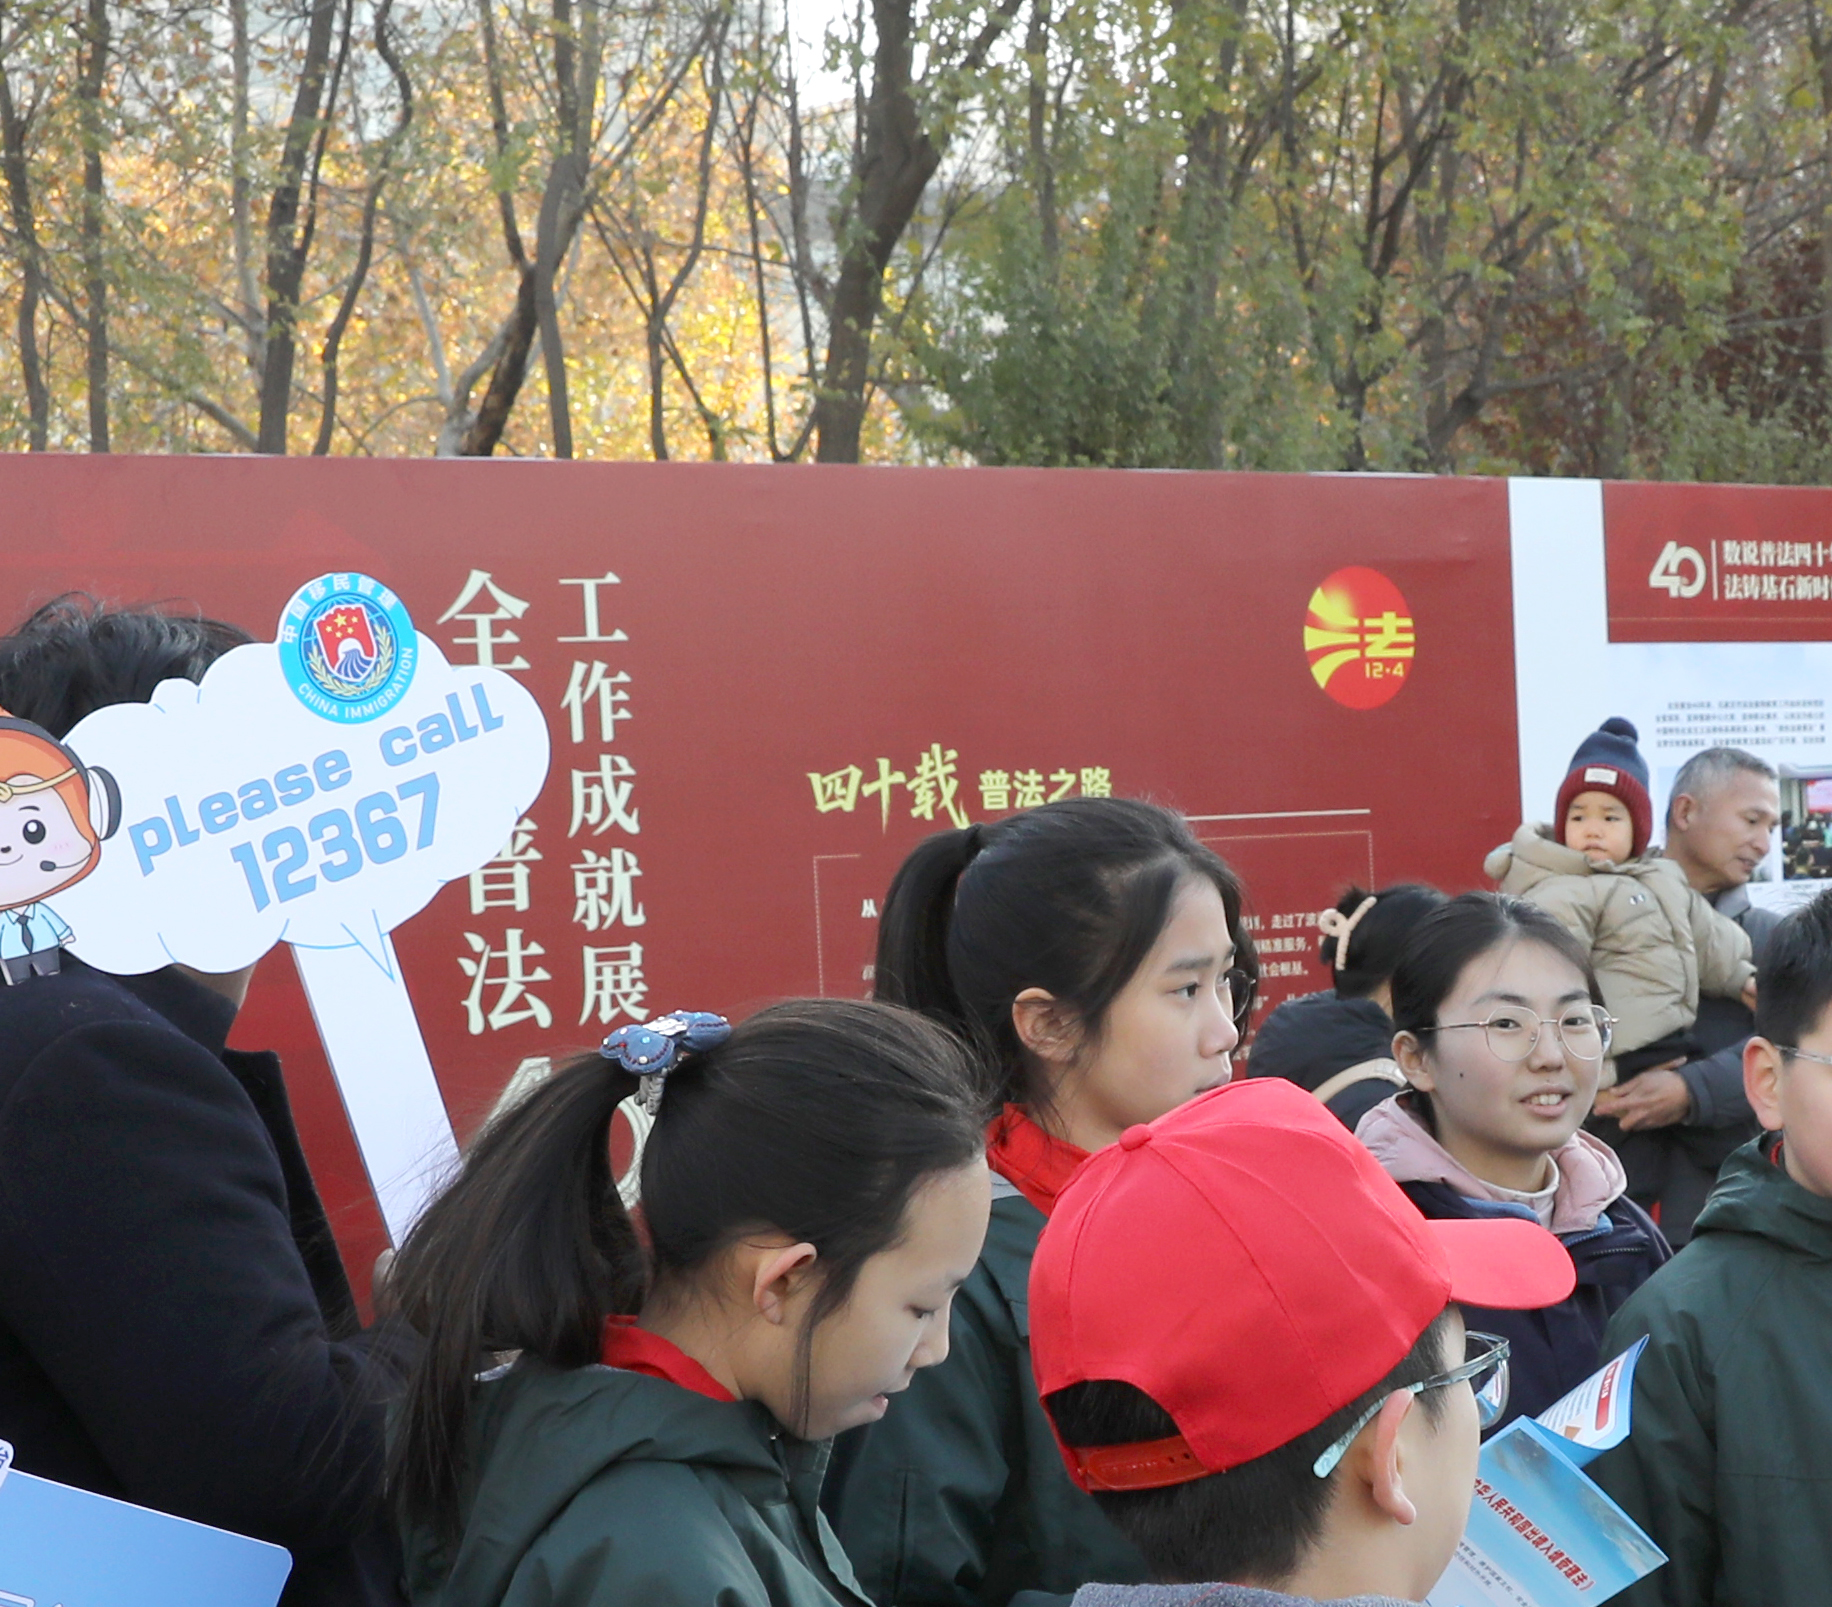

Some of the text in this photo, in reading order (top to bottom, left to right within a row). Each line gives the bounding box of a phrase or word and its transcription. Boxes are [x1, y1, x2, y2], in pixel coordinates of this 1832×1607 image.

[282, 573, 399, 644] 中国移民管理
[298, 646, 415, 719] CHINA IMMIGRATION
[127, 682, 506, 877] please call
[230, 772, 444, 914] 12367
[437, 568, 553, 1037] 全普法
[556, 570, 650, 1027] 工作成就展
[807, 742, 1114, 834] 四十载 普法之路
